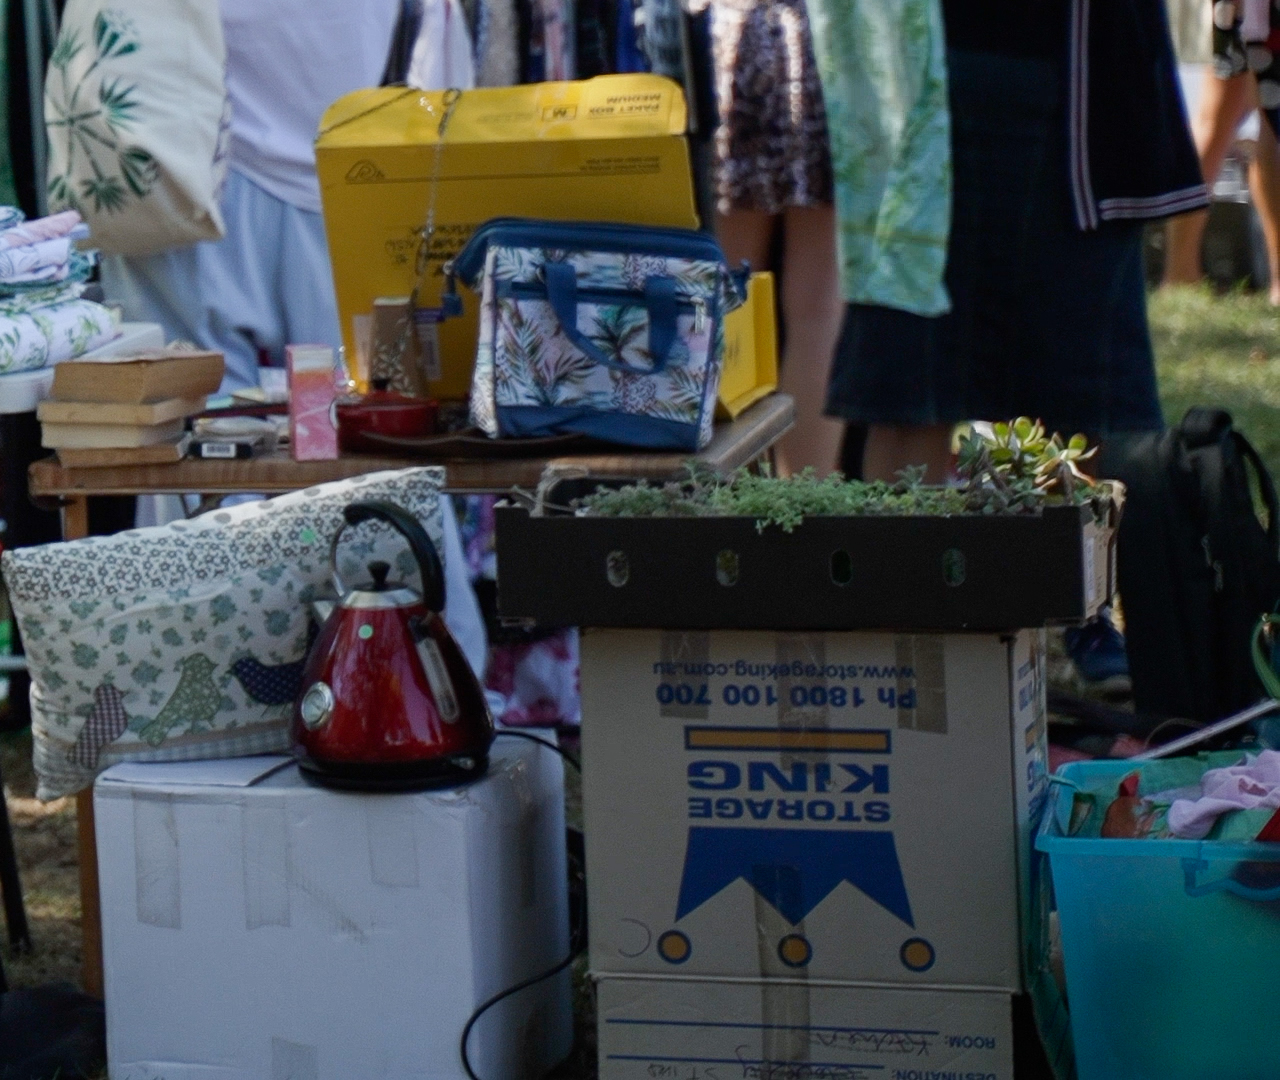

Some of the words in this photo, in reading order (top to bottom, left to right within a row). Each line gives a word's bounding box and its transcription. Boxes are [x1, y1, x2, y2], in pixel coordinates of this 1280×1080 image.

[653, 660, 916, 682] www.storageking.com.au
[656, 683, 711, 706] 700
[723, 684, 779, 708] 100
[790, 686, 865, 708] 1800
[878, 686, 917, 709] Ph
[687, 760, 890, 794] KING
[687, 797, 890, 823] STORAGE
[944, 1036, 996, 1049] ROOM:
